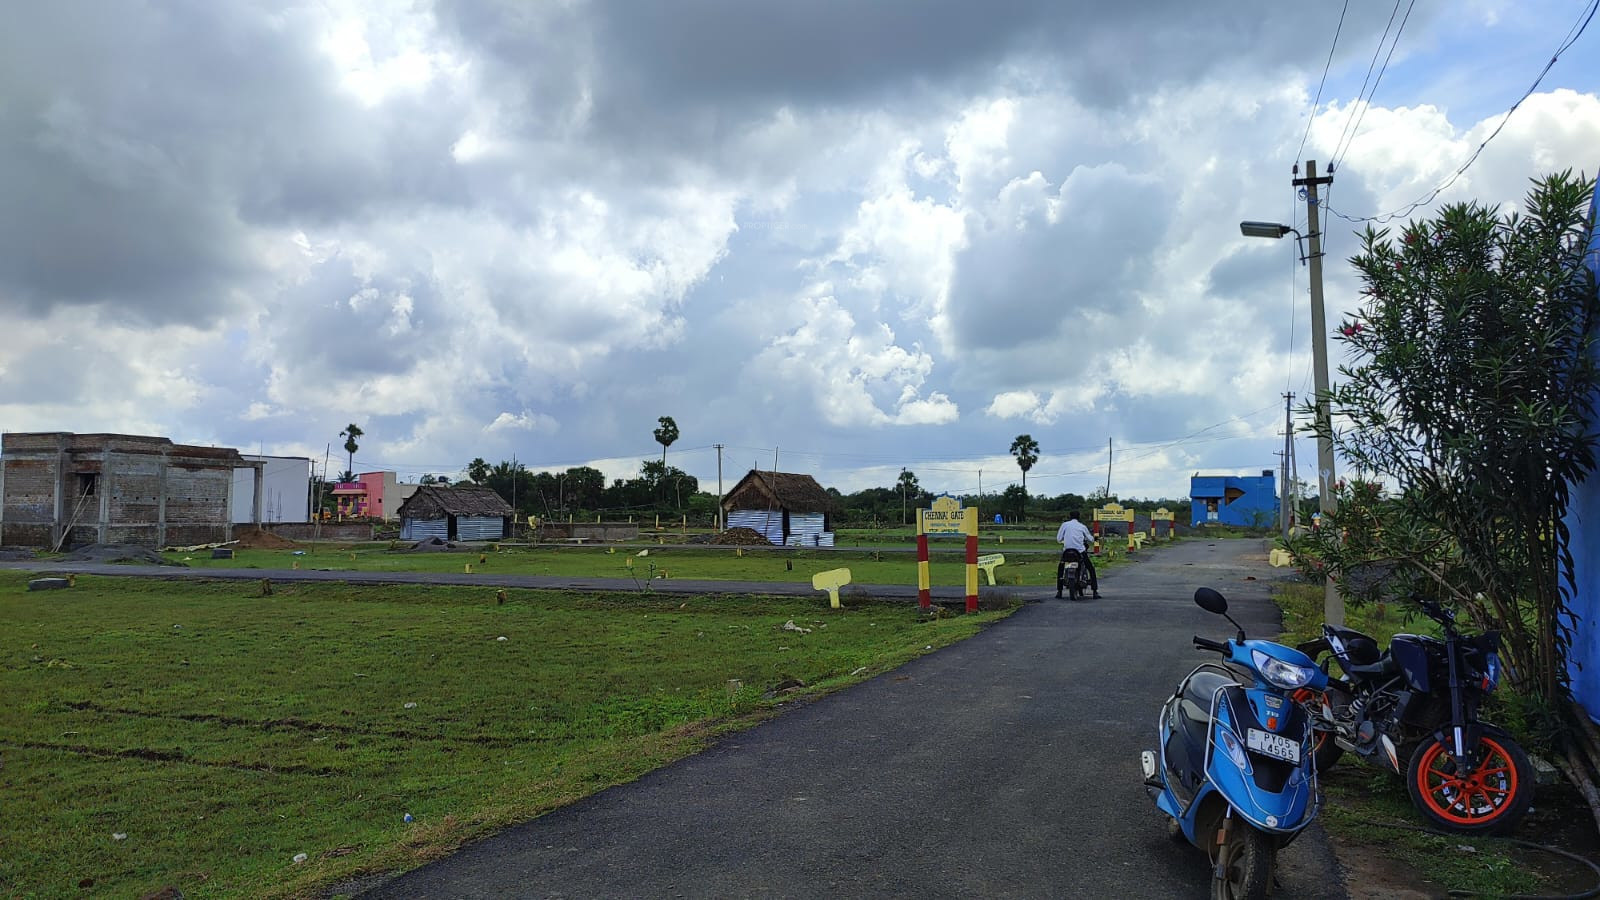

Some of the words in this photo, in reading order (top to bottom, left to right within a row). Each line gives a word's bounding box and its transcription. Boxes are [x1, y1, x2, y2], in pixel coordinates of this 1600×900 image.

[925, 511, 948, 520] CHENNAI
[951, 511, 964, 520] GATE
[1264, 733, 1291, 749] PY05
[1260, 741, 1294, 760] L4565
